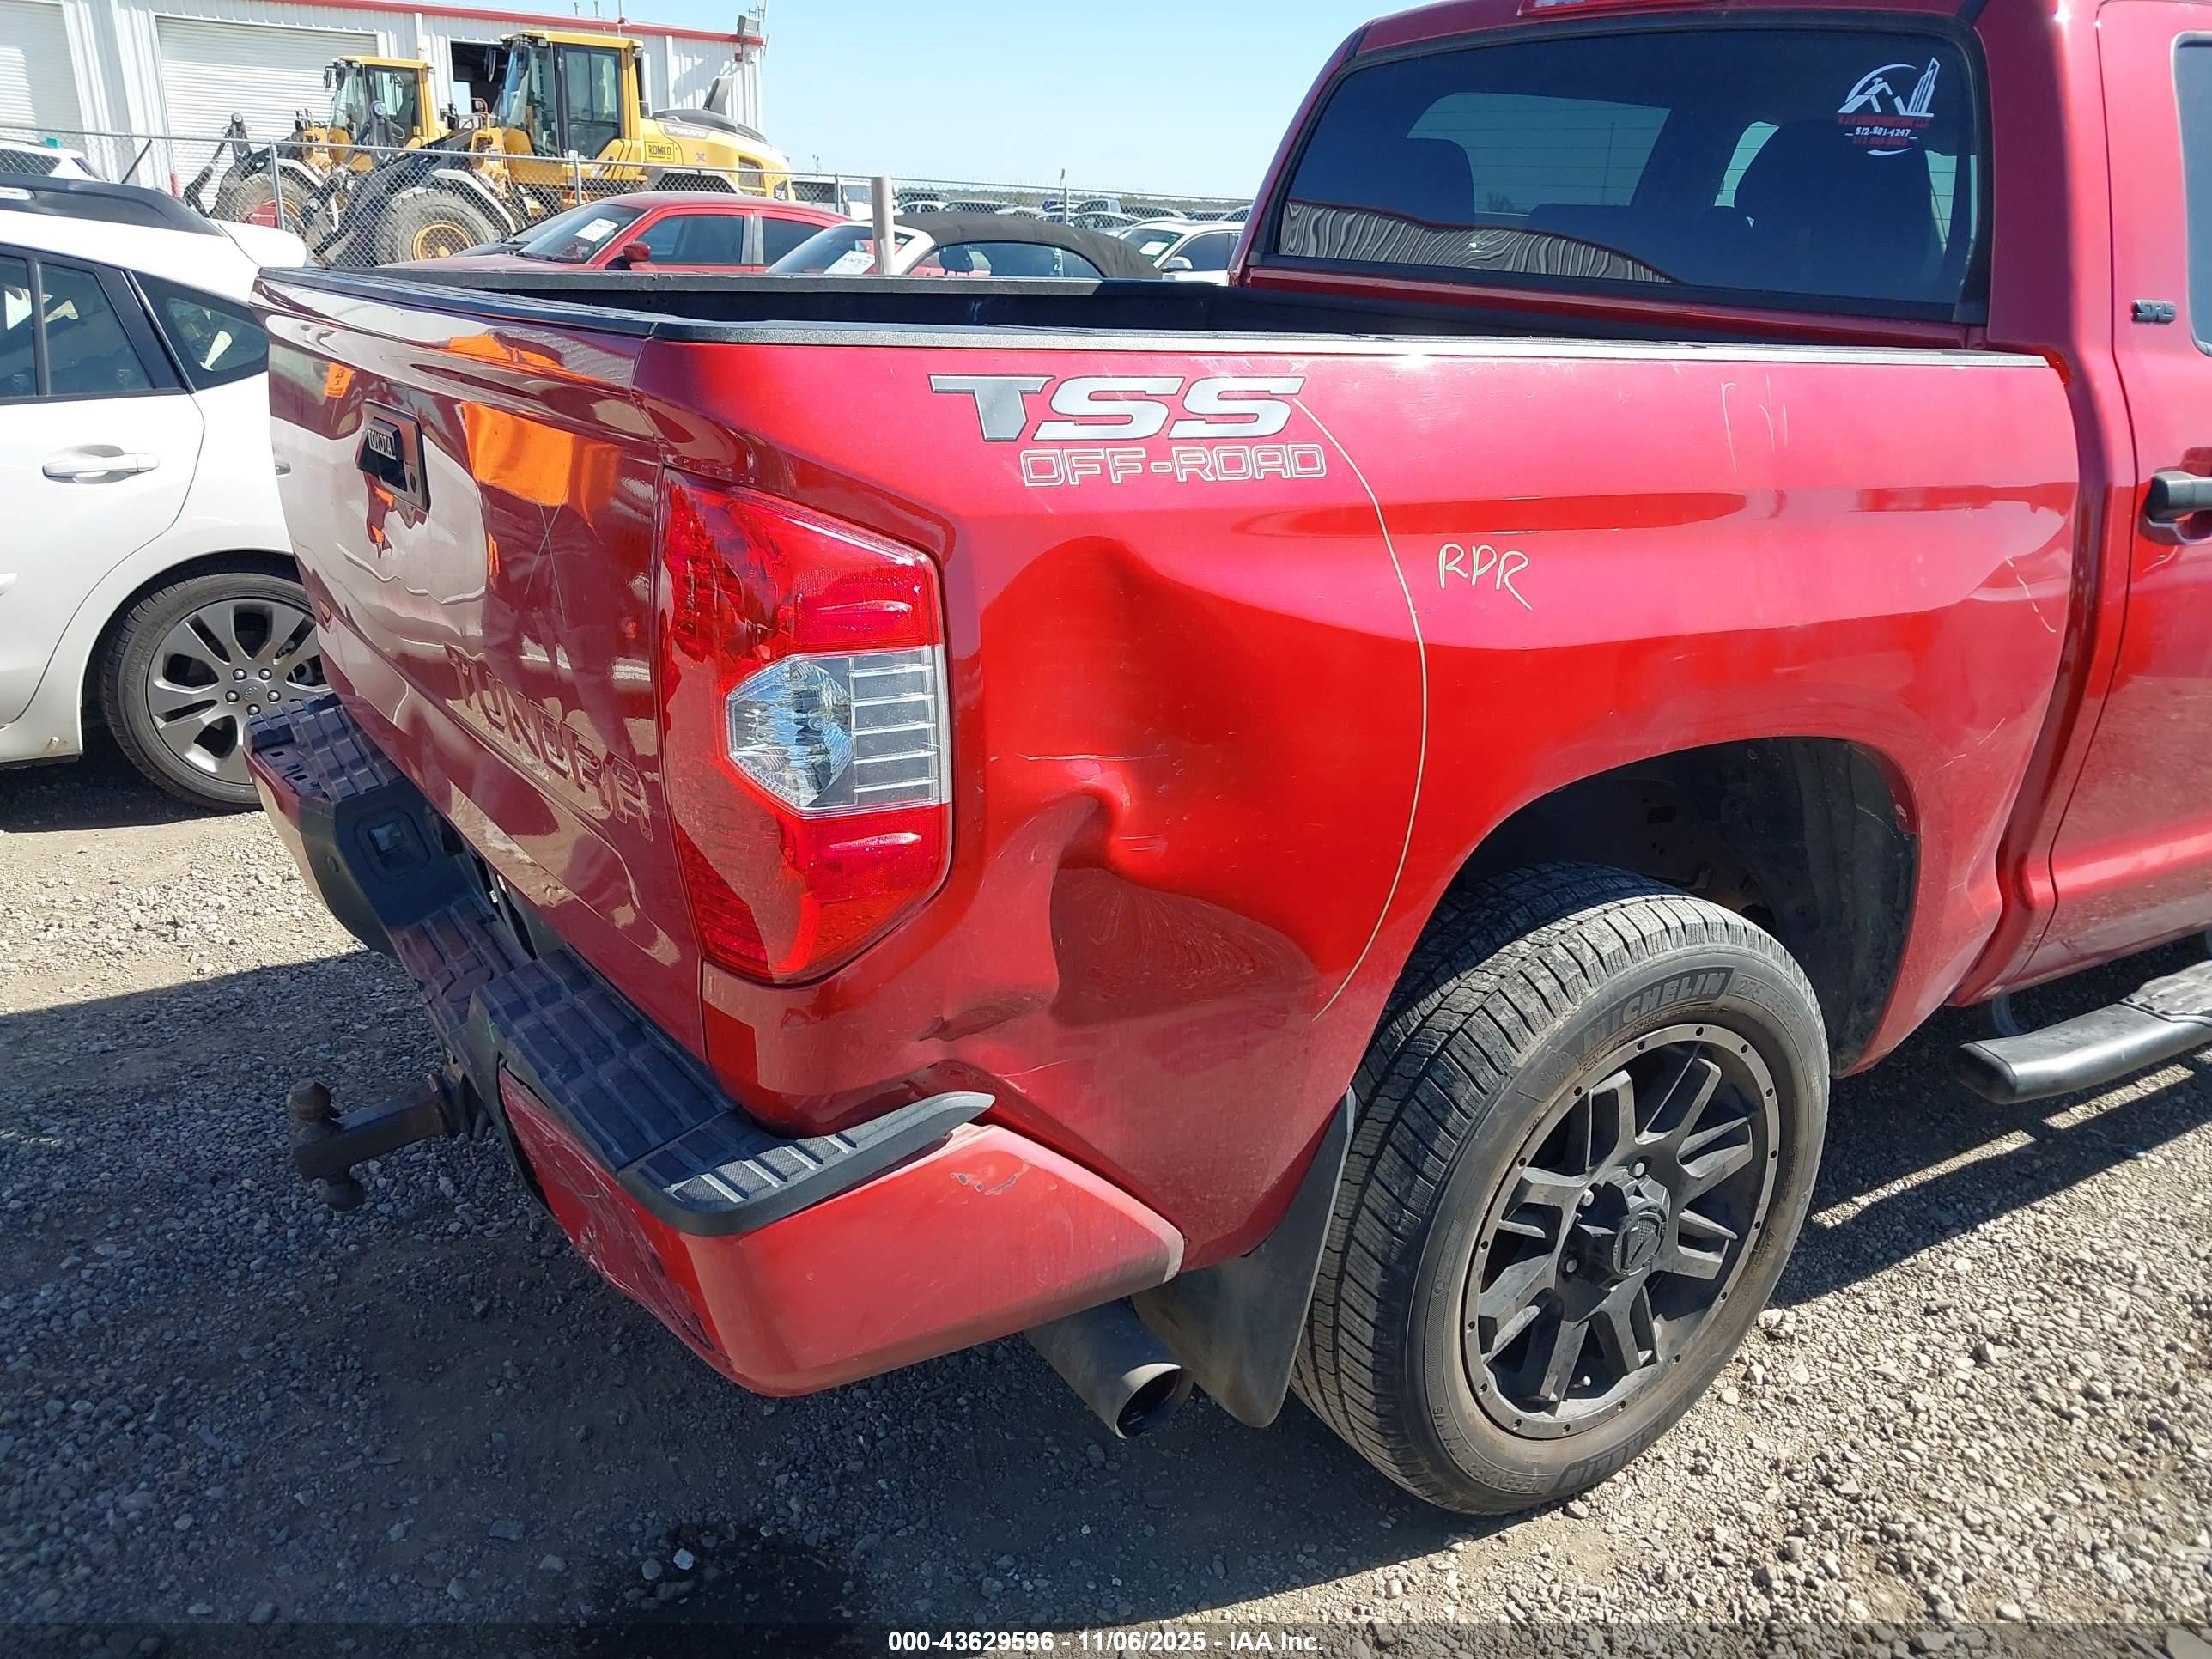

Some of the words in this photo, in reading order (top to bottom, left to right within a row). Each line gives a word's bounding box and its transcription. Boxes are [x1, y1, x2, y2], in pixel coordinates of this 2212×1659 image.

[648, 144, 672, 156] ROMCO
[2132, 299, 2176, 324] SR5
[927, 374, 1306, 442] TSS
[368, 428, 393, 456] TOYOTA
[1019, 442, 1328, 488] OFF-ROAD
[444, 641, 653, 842] TUNDRA
[1583, 972, 1726, 1054] MICHELIN
